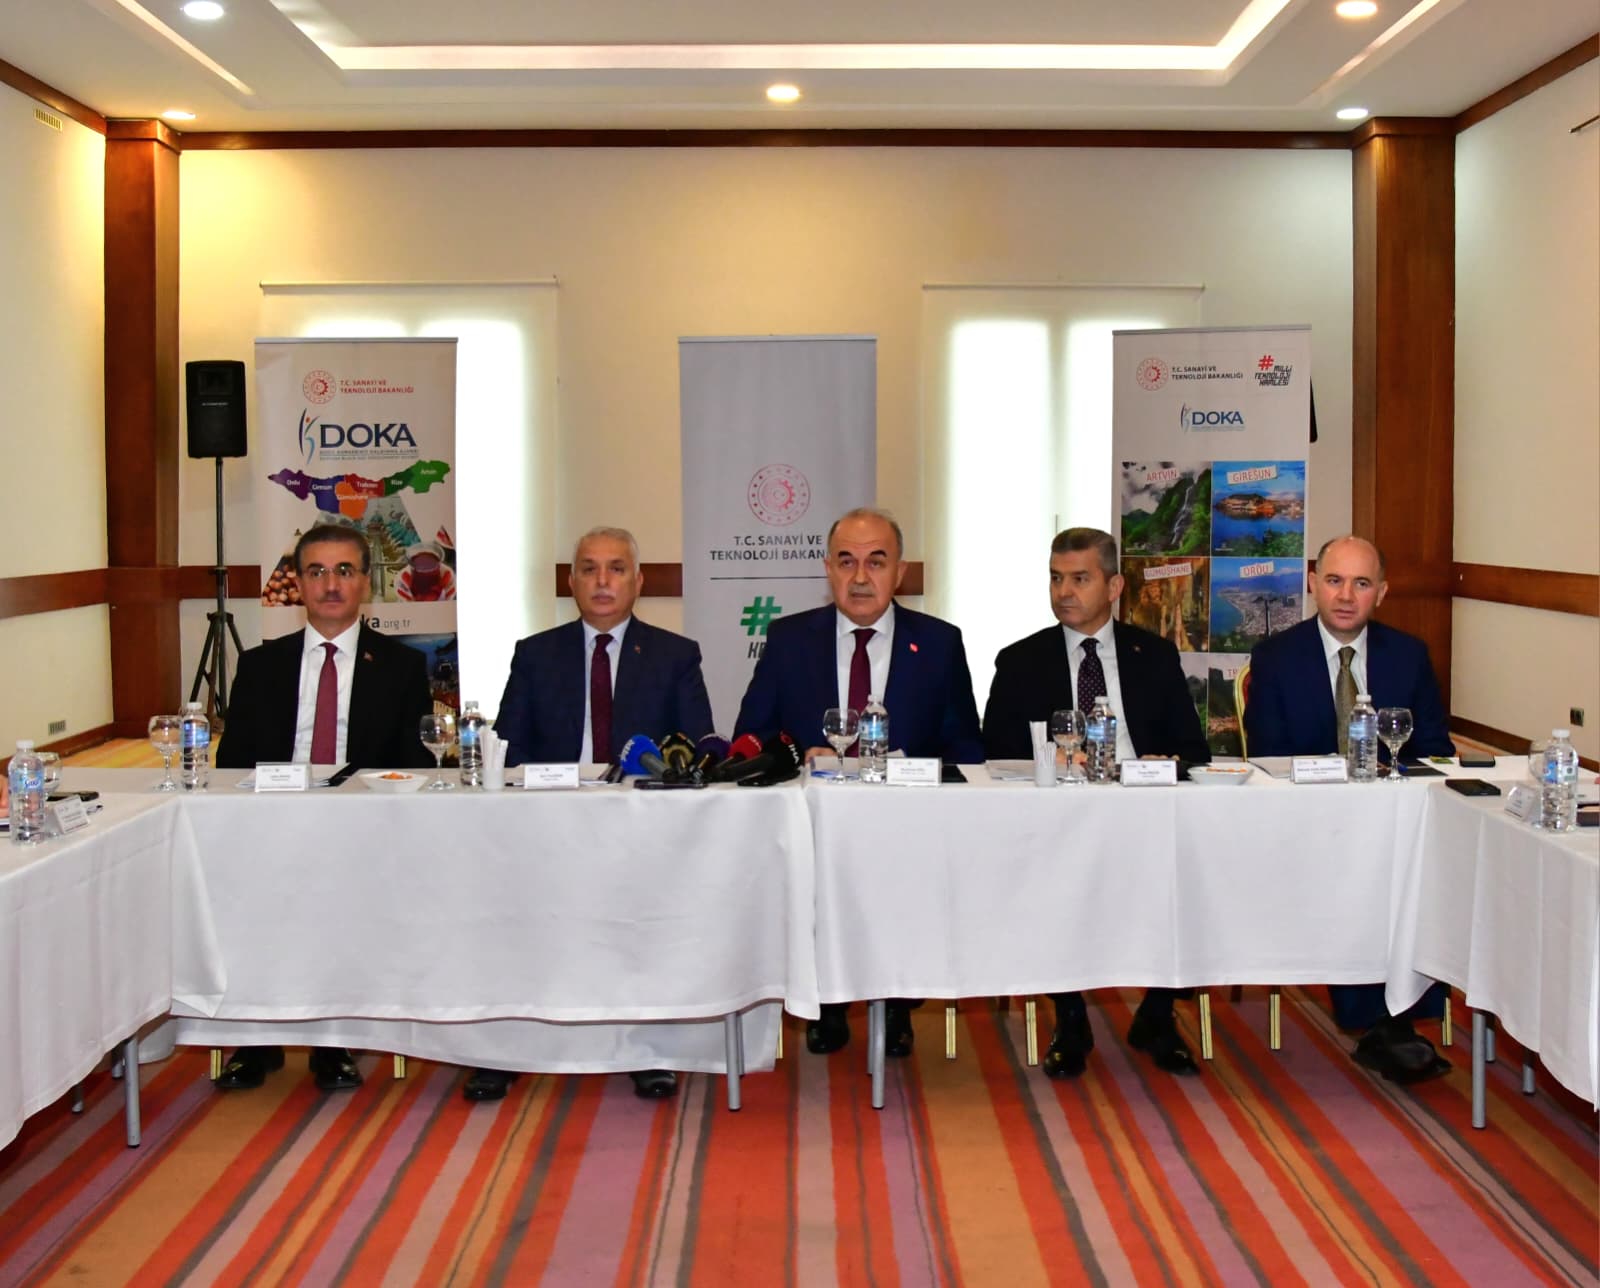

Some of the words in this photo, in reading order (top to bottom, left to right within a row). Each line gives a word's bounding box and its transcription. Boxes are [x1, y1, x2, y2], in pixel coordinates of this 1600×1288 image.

[1192, 411, 1244, 426] DOKA
[320, 423, 417, 448] DOKA
[734, 536, 755, 546] T.C.
[758, 533, 803, 546] SANAYİ
[807, 535, 823, 545] VE
[710, 548, 778, 561] TEKNOLOJİ
[782, 549, 826, 560] BAKAN
